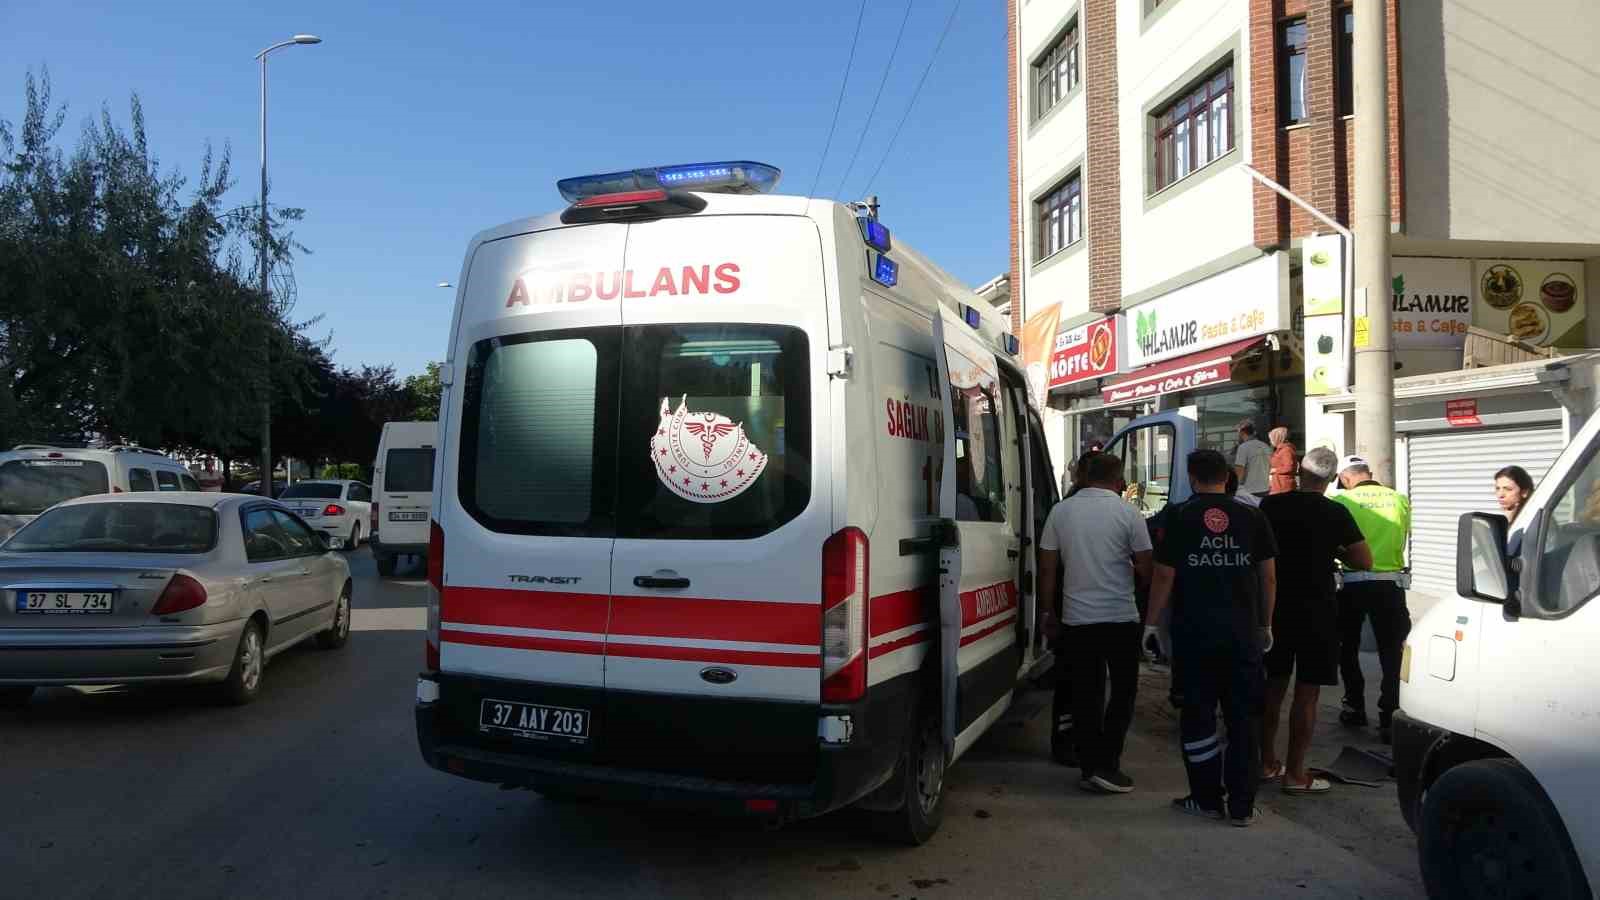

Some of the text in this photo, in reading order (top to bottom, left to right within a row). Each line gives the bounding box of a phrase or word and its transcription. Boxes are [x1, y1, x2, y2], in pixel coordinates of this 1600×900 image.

[505, 262, 742, 308] AMBULANS
[886, 394, 929, 442] SAĞLIK
[1200, 534, 1240, 549] ACİL
[1187, 551, 1251, 567] SAĞLIK
[508, 574, 582, 585] TRANSIT
[28, 593, 108, 609] 37 SL 734
[493, 703, 584, 734] 37 AAY 203
